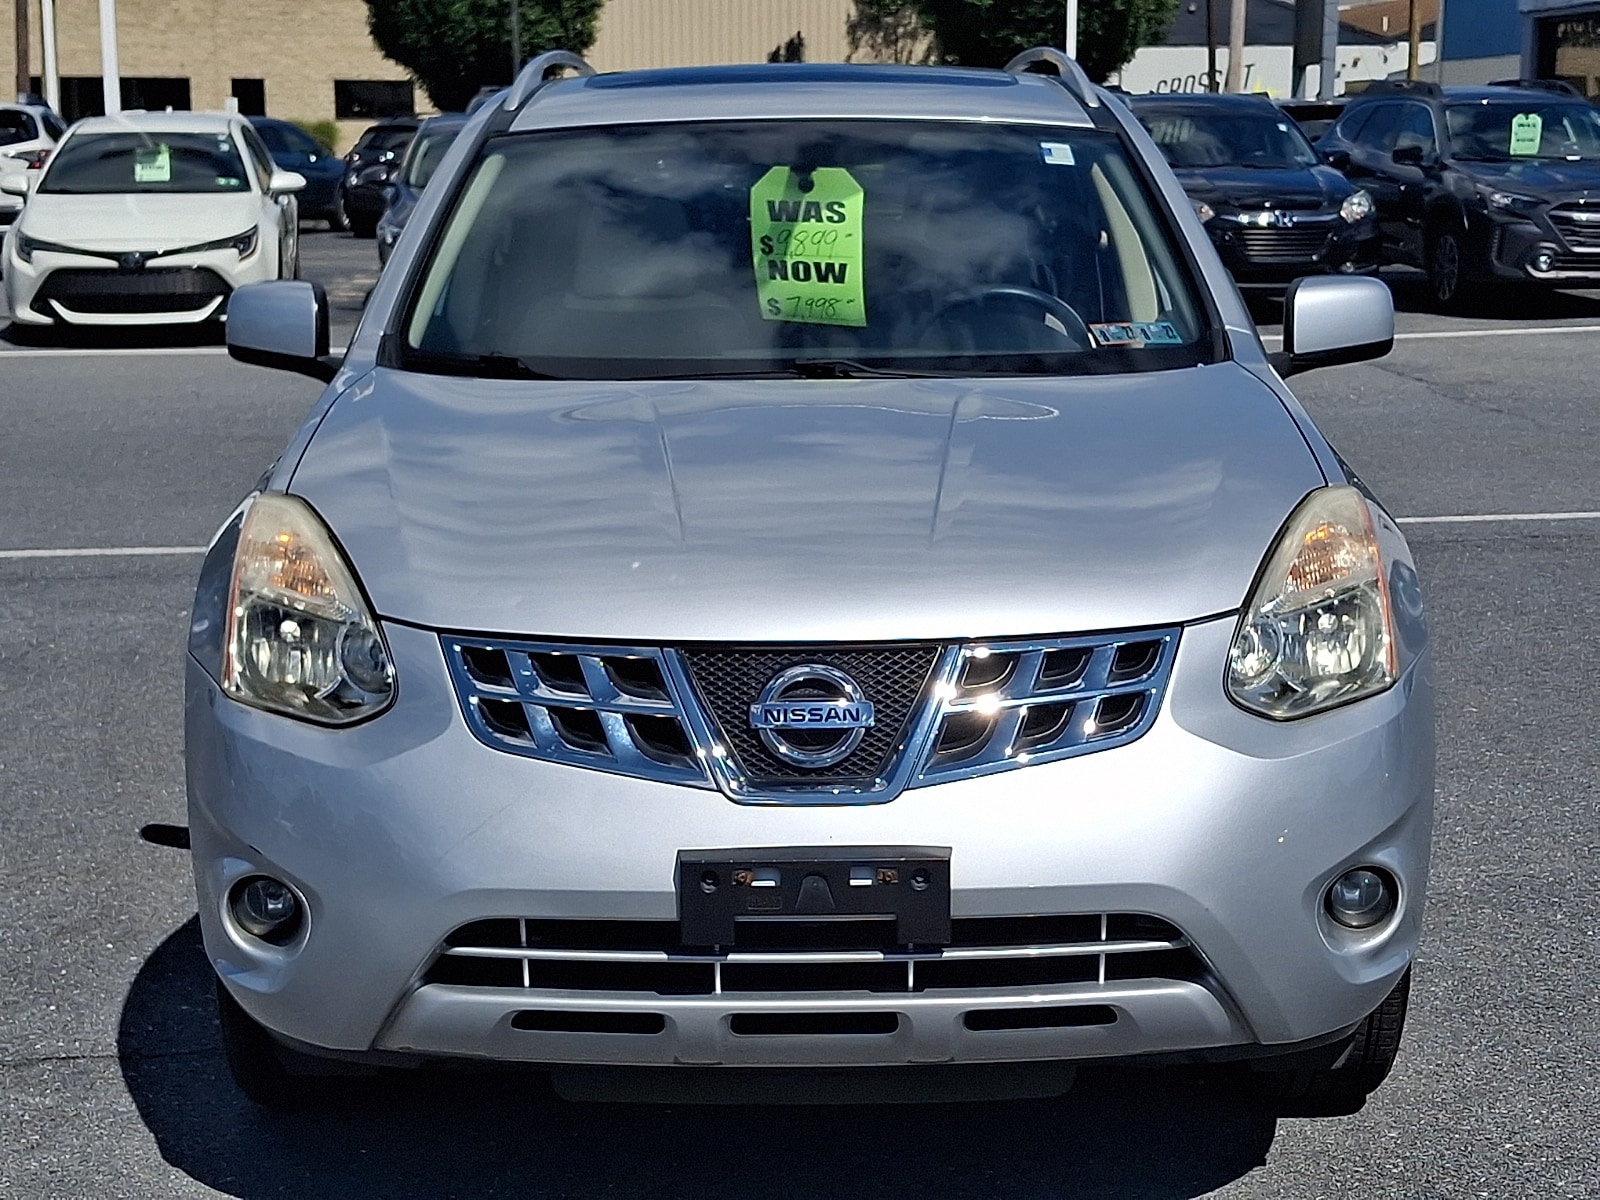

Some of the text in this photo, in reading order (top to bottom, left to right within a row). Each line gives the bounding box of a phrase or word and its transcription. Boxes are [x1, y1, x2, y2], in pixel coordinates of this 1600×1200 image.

[766, 200, 846, 224] WAS
[767, 260, 848, 284] NOW
[763, 707, 860, 723] NISSAN
